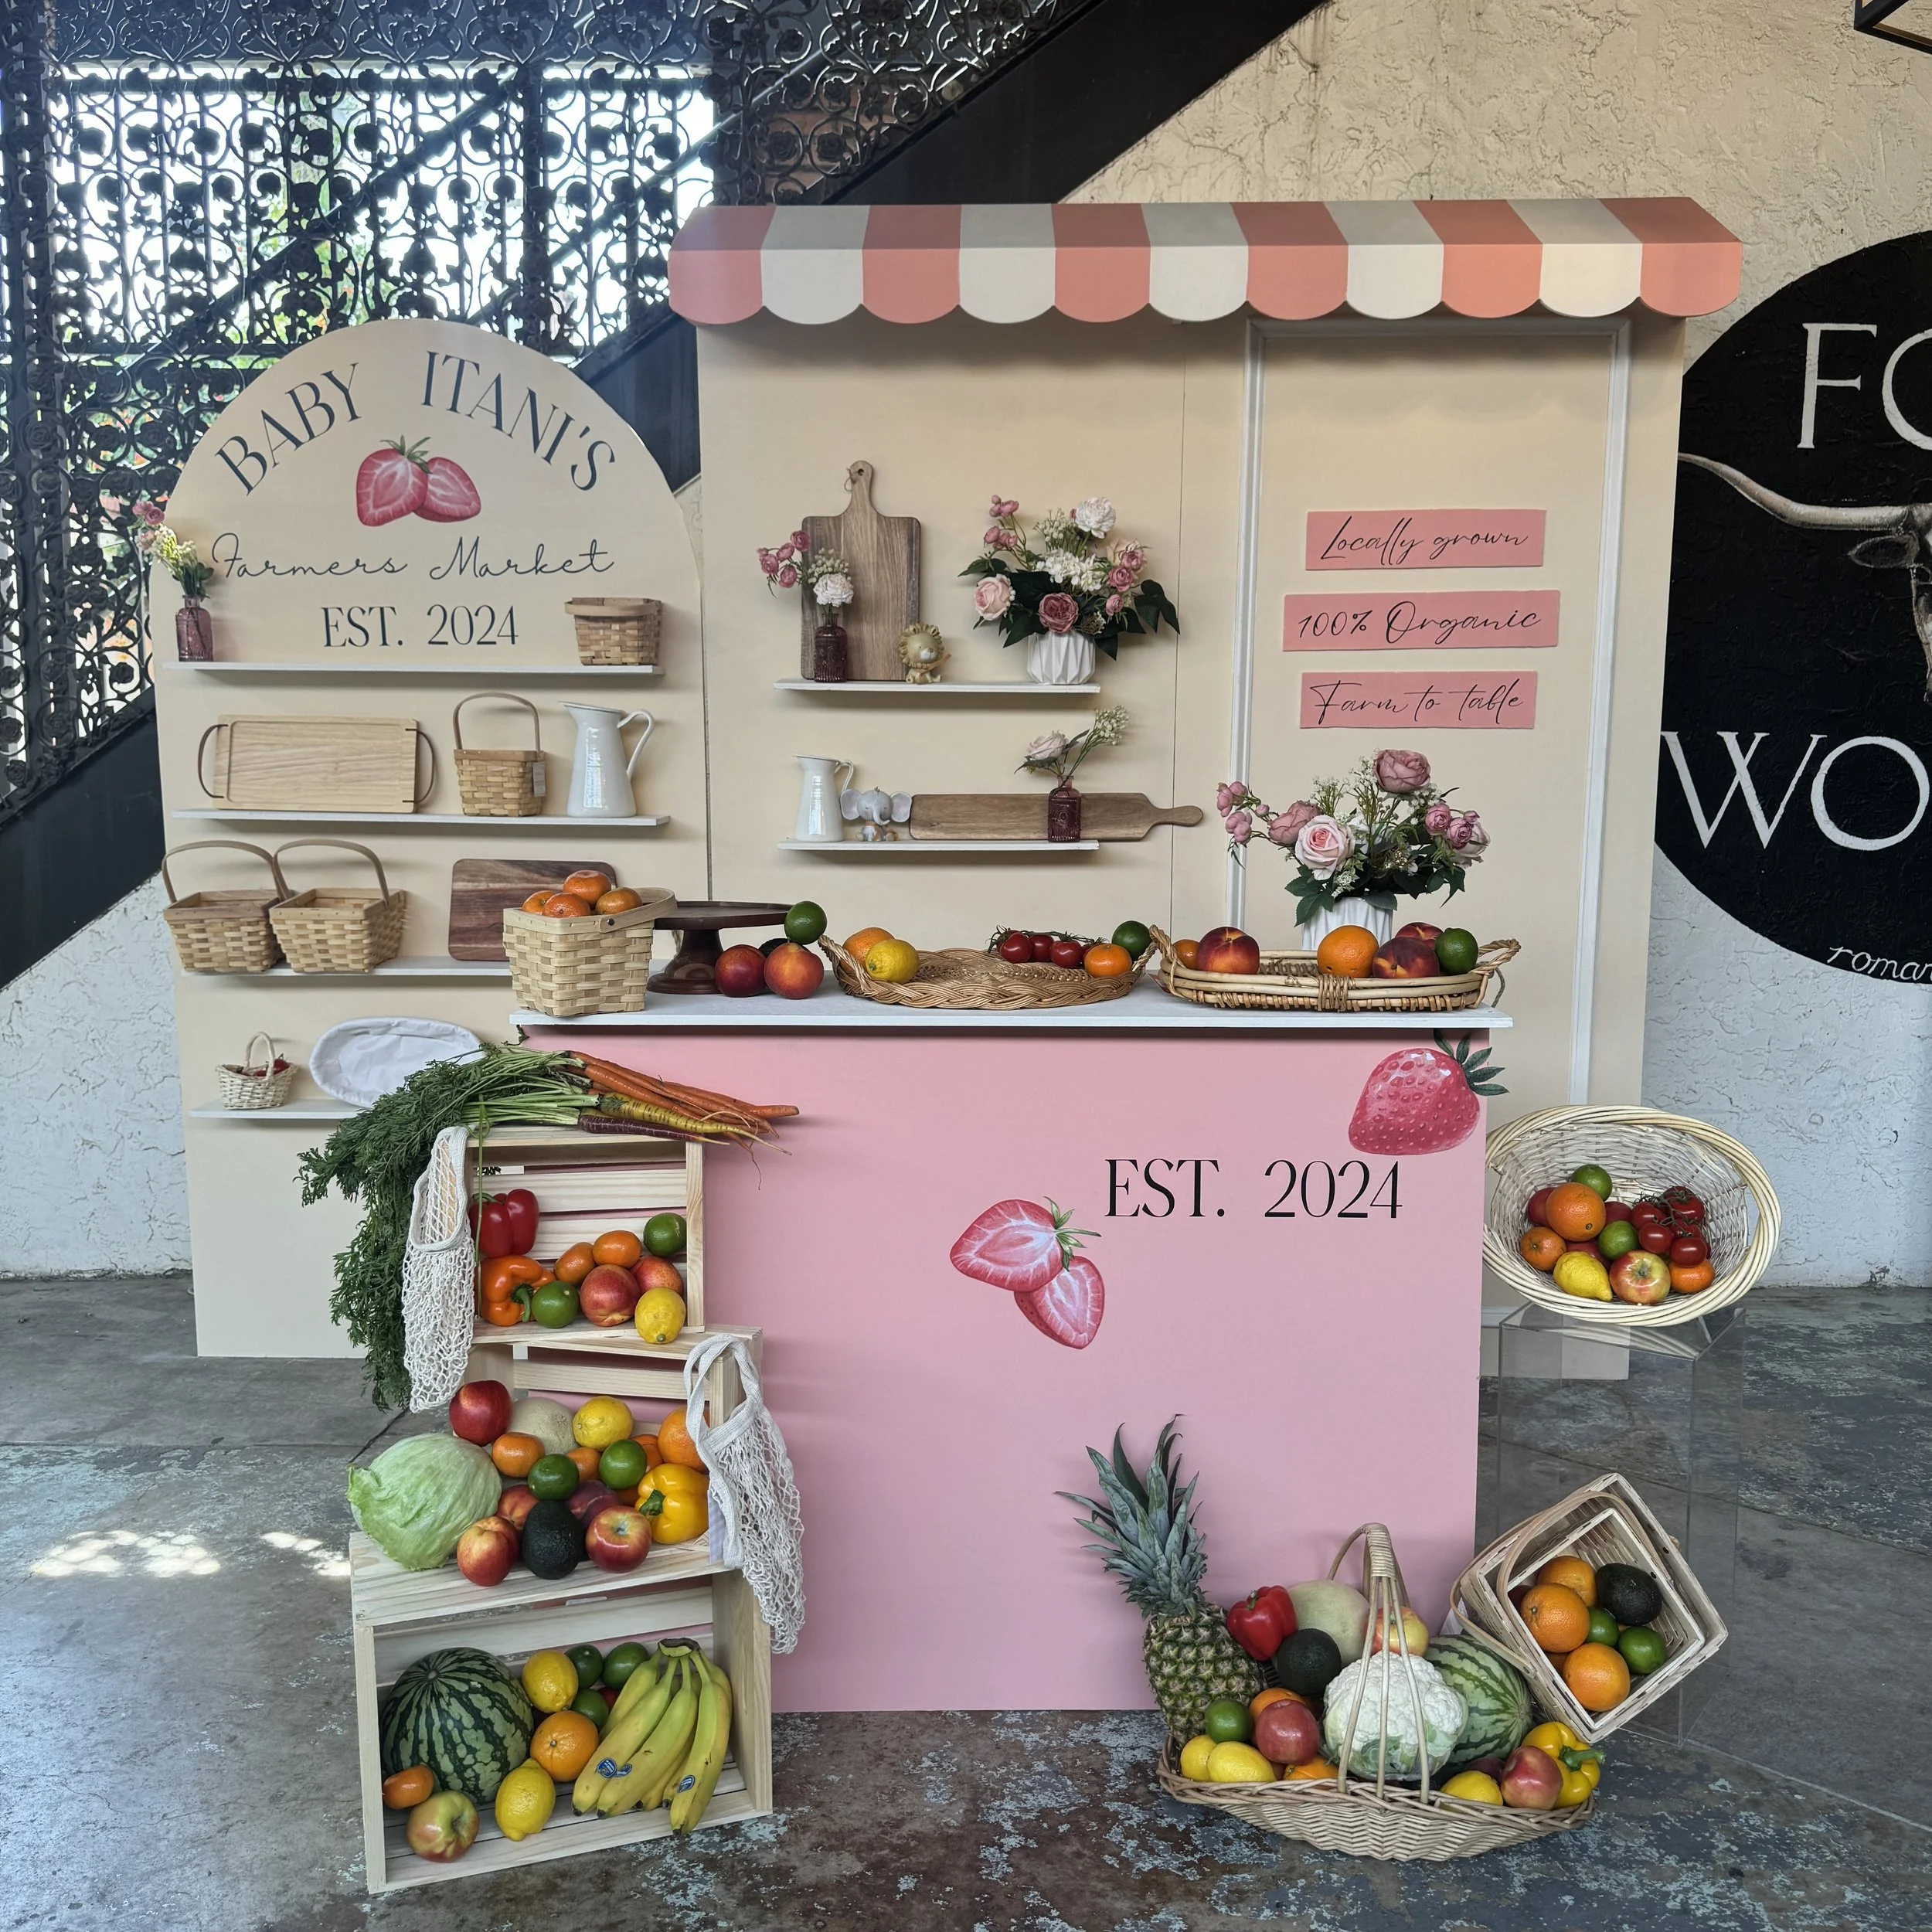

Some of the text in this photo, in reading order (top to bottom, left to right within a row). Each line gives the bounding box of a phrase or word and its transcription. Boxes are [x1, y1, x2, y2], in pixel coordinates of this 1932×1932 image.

[215, 351, 616, 496] BABY ITANI'S
[211, 532, 615, 581] Farmers Market
[1320, 515, 1529, 566] Locally grown
[321, 604, 519, 648] EST. 2024
[1298, 600, 1542, 645] 100% Organic
[1309, 679, 1523, 725] Farm to table
[1104, 1158, 1403, 1219] EST. 2024
